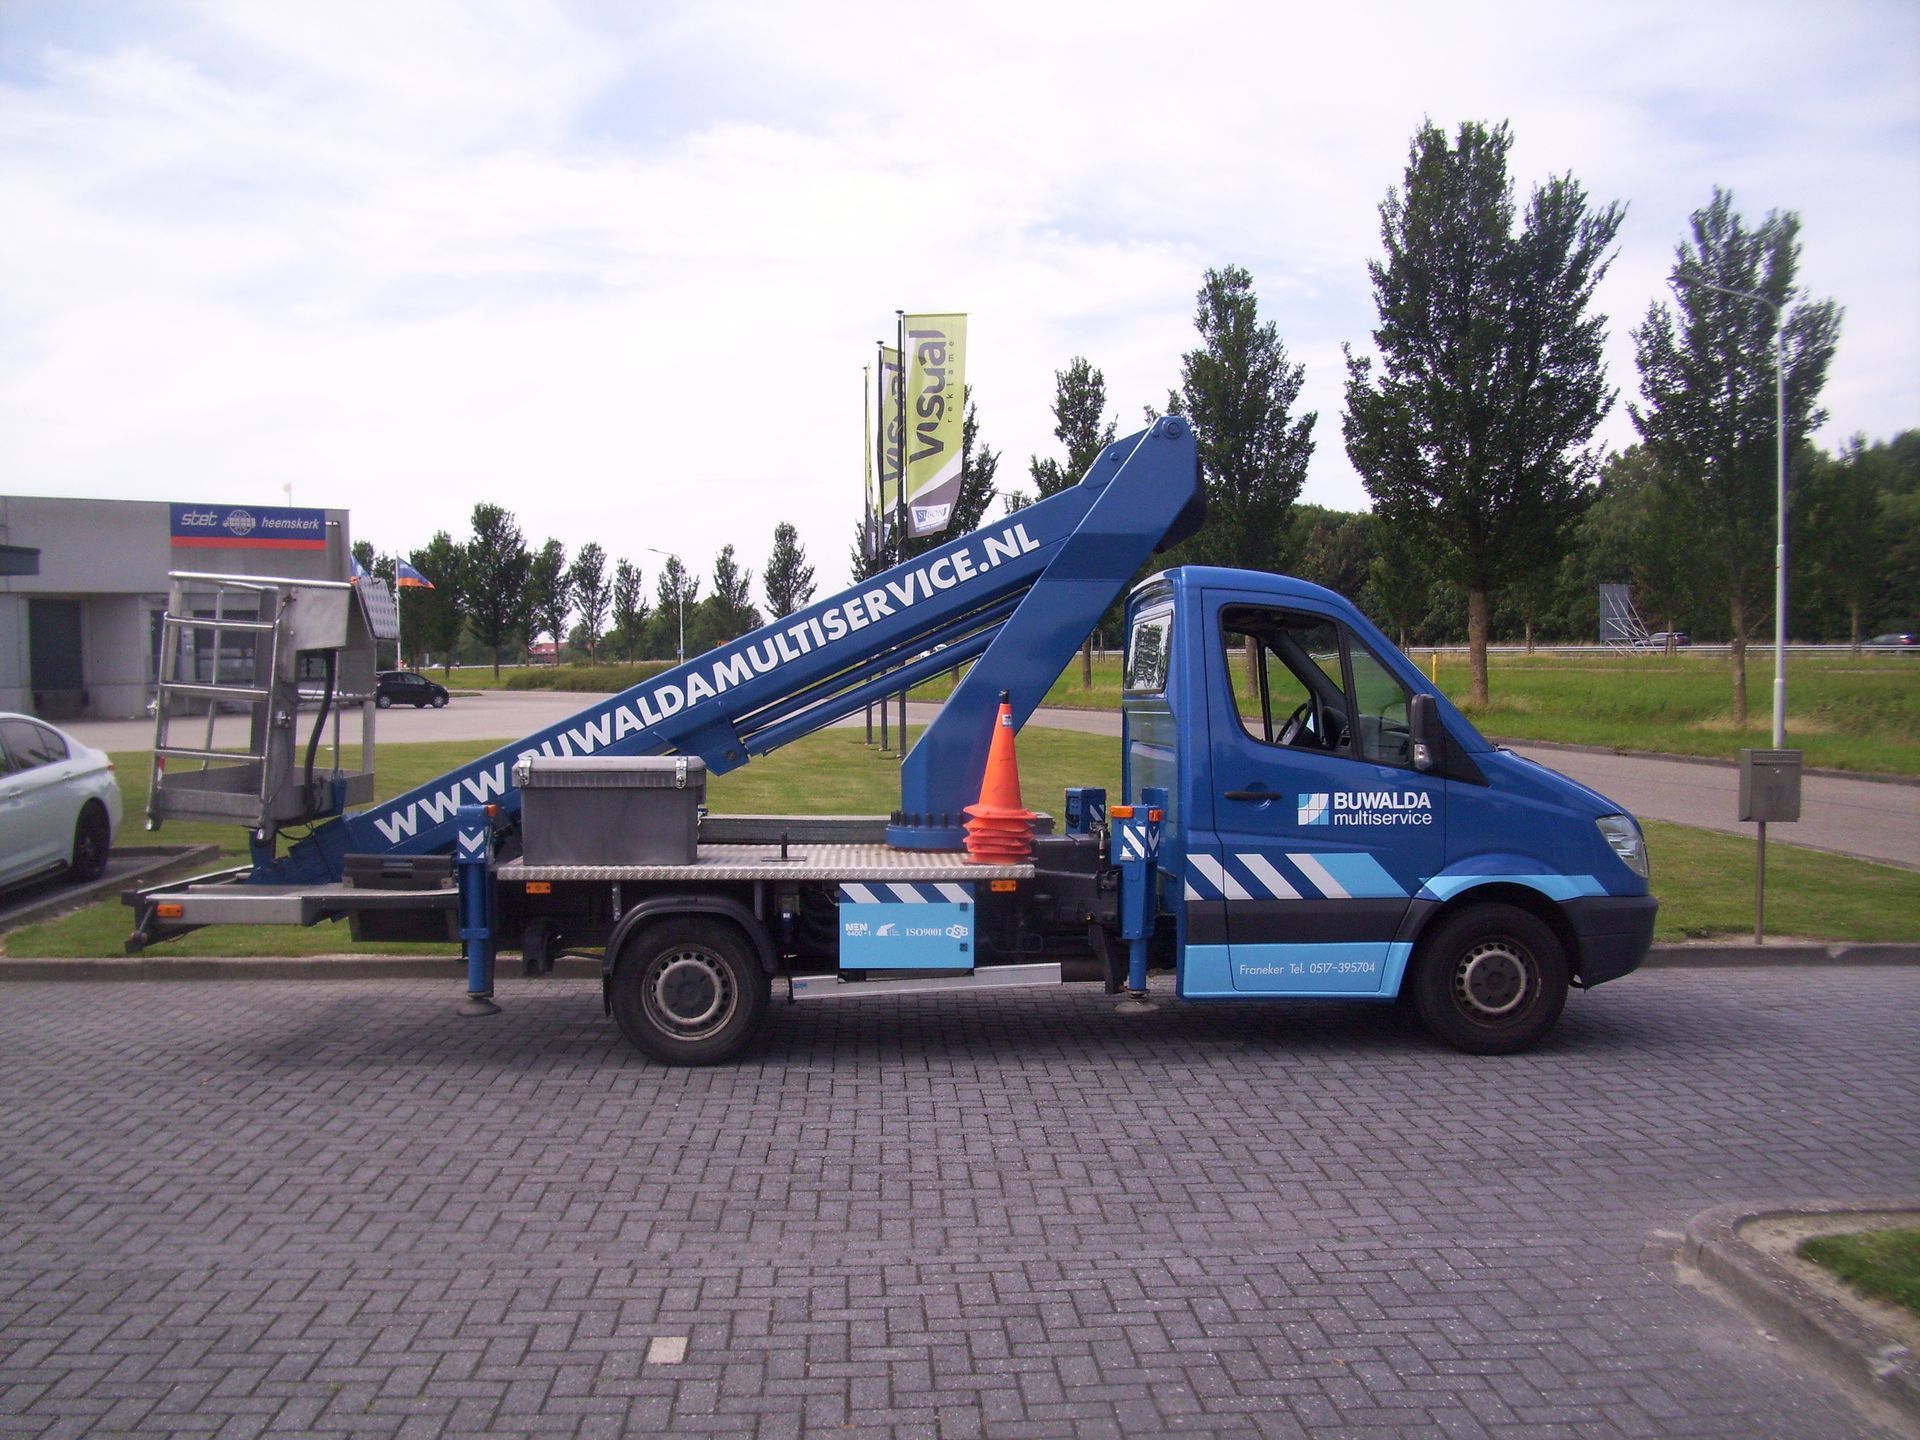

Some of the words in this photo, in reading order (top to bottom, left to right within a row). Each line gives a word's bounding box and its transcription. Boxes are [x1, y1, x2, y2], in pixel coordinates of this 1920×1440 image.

[946, 341, 955, 423] reklame
[909, 330, 946, 464] visual
[181, 511, 218, 526] stet
[261, 517, 320, 529] heemskerk
[373, 523, 1040, 844] WWWUWALDAMULTISERVICE.NL
[1334, 792, 1432, 809] BUWALDA
[1334, 810, 1432, 825] multiservice
[845, 923, 868, 931] NEN
[906, 928, 942, 937] ISO9001
[1239, 963, 1285, 975] Franeker
[1289, 963, 1305, 974] Tel.
[1309, 962, 1376, 974] 0517-395704
